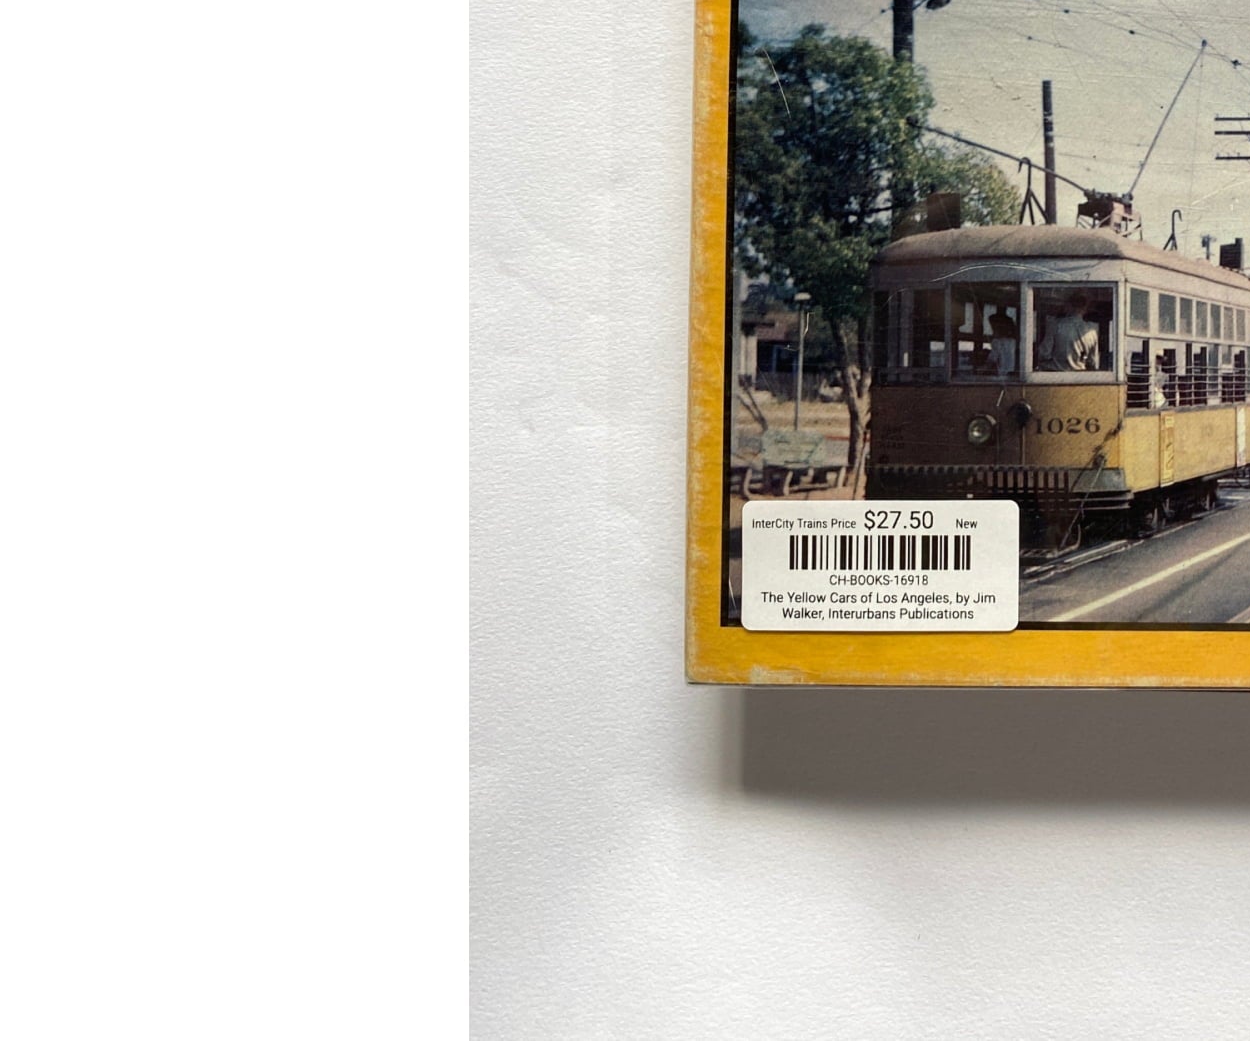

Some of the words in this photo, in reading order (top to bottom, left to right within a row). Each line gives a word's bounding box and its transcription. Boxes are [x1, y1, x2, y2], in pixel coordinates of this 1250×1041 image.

[1035, 416, 1102, 435] 1026
[752, 518, 795, 531] InterCity
[798, 518, 828, 529] Trains
[831, 518, 857, 529] Price
[864, 510, 935, 531] $27.50
[956, 518, 978, 529] New
[829, 574, 929, 586] CH-BOOKS-16918
[761, 591, 784, 604] The
[787, 591, 826, 604] Yellow
[830, 591, 857, 604] Cars
[860, 591, 873, 604] of
[876, 591, 898, 604] Los
[901, 591, 953, 606] Angeles,
[955, 591, 970, 606] by
[973, 591, 996, 604] Jim
[782, 607, 825, 621] Walker,
[828, 607, 896, 620] Interurbans
[899, 607, 974, 620] Publications
